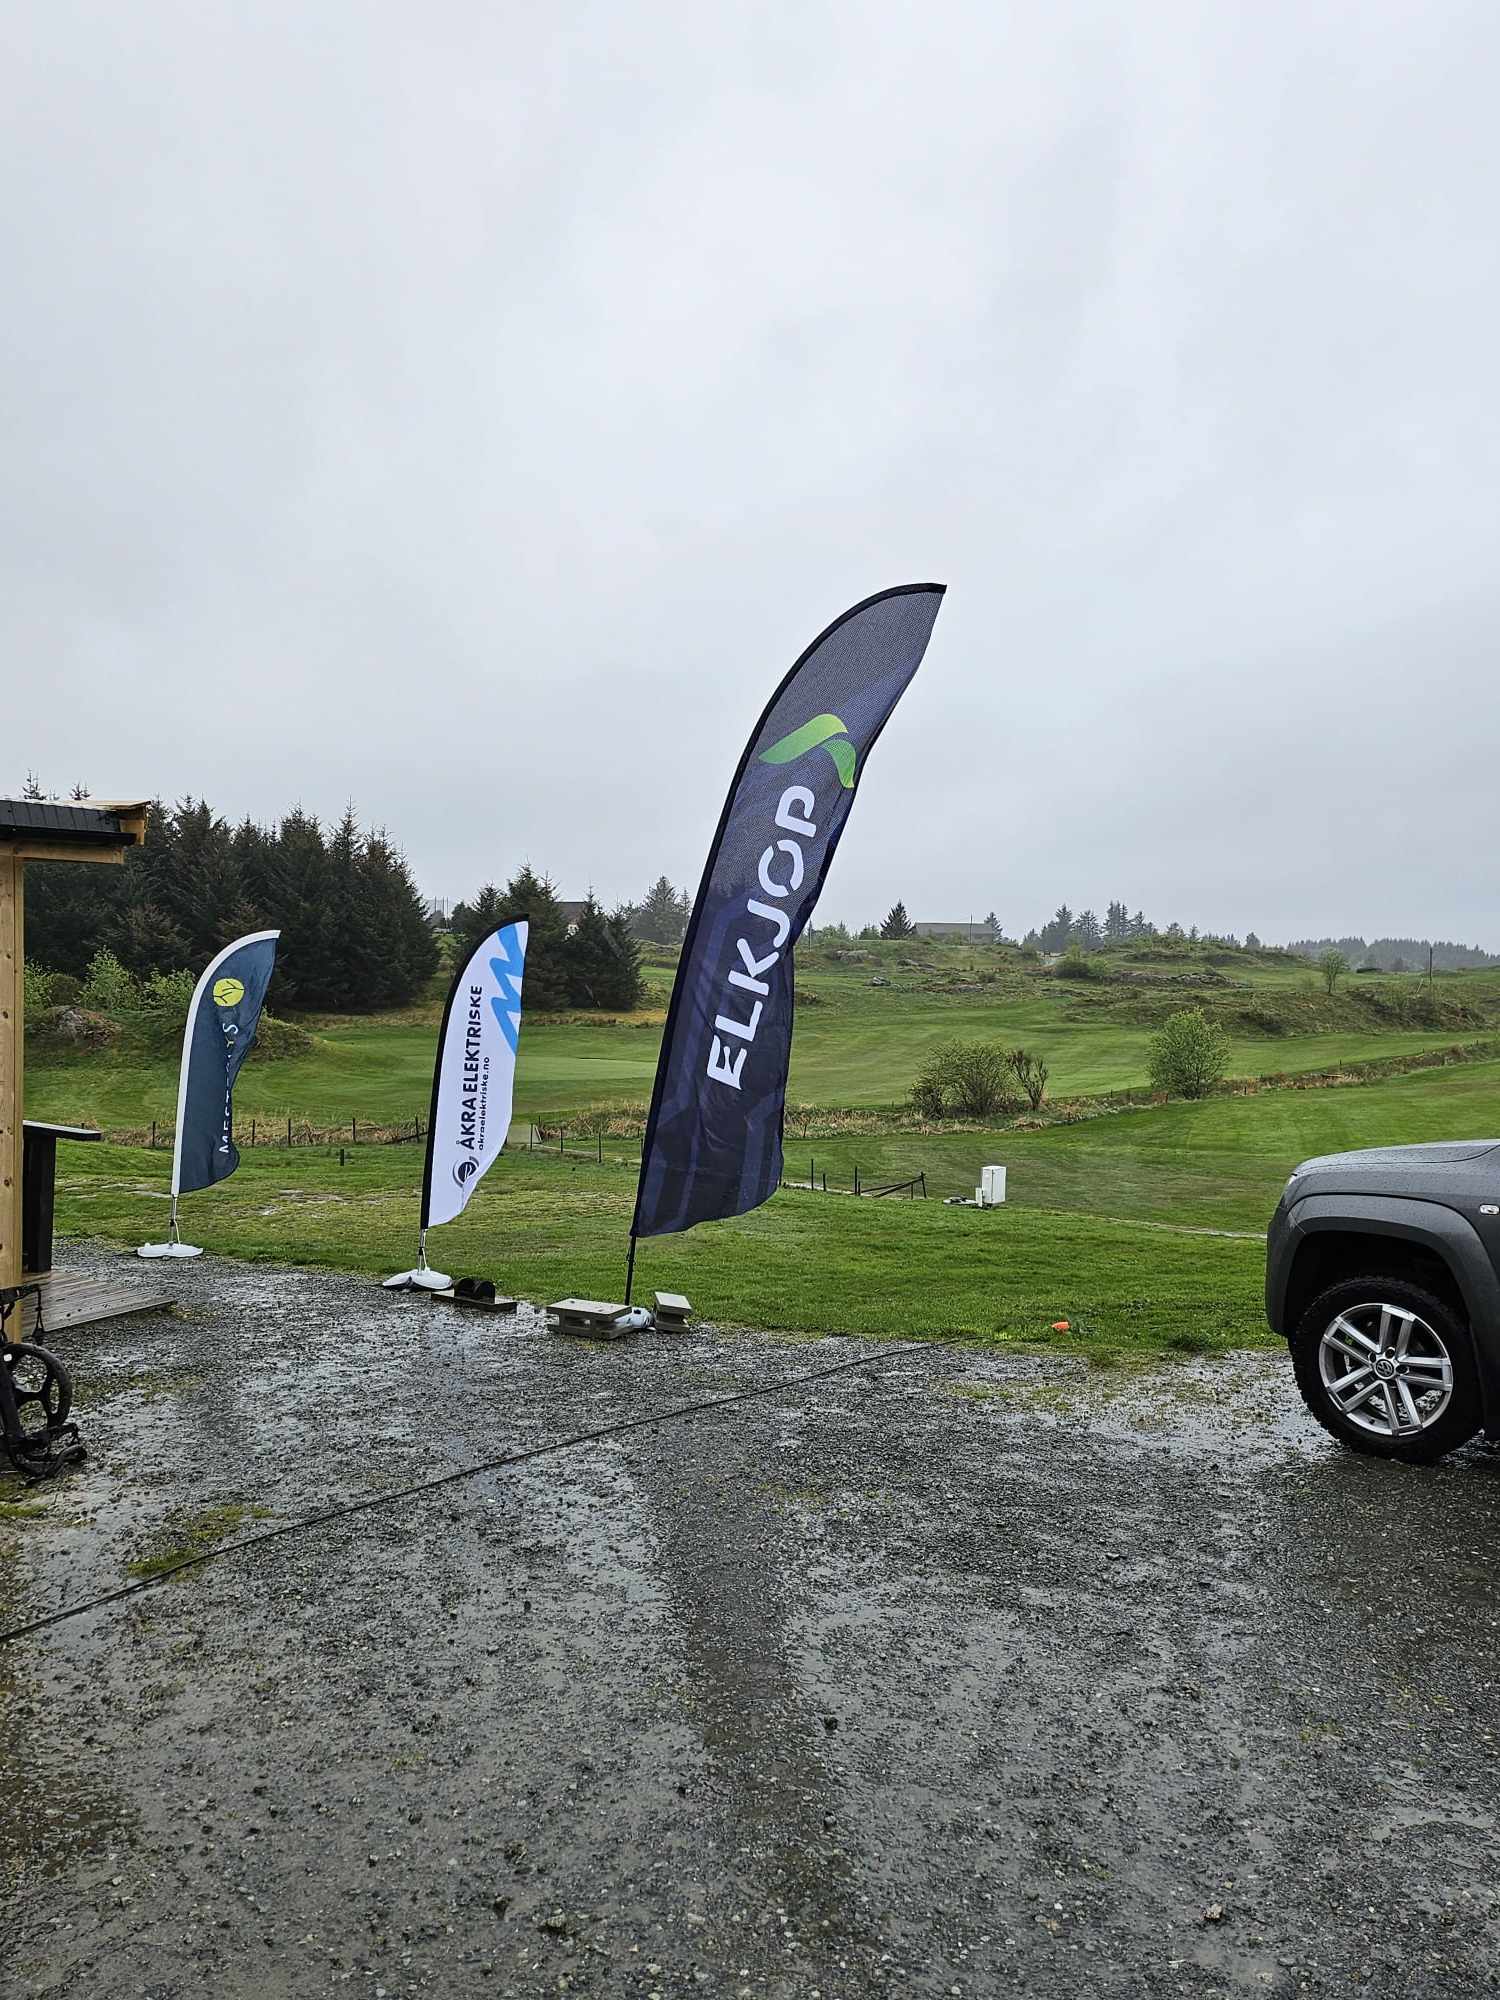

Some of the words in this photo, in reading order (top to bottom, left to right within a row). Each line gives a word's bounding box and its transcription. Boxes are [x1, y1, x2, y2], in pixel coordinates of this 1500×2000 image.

[462, 985, 483, 1093] ELEKTRISKE
[456, 1097, 477, 1150] ÅKRA
[478, 1056, 490, 1151] akraelektriske.no
